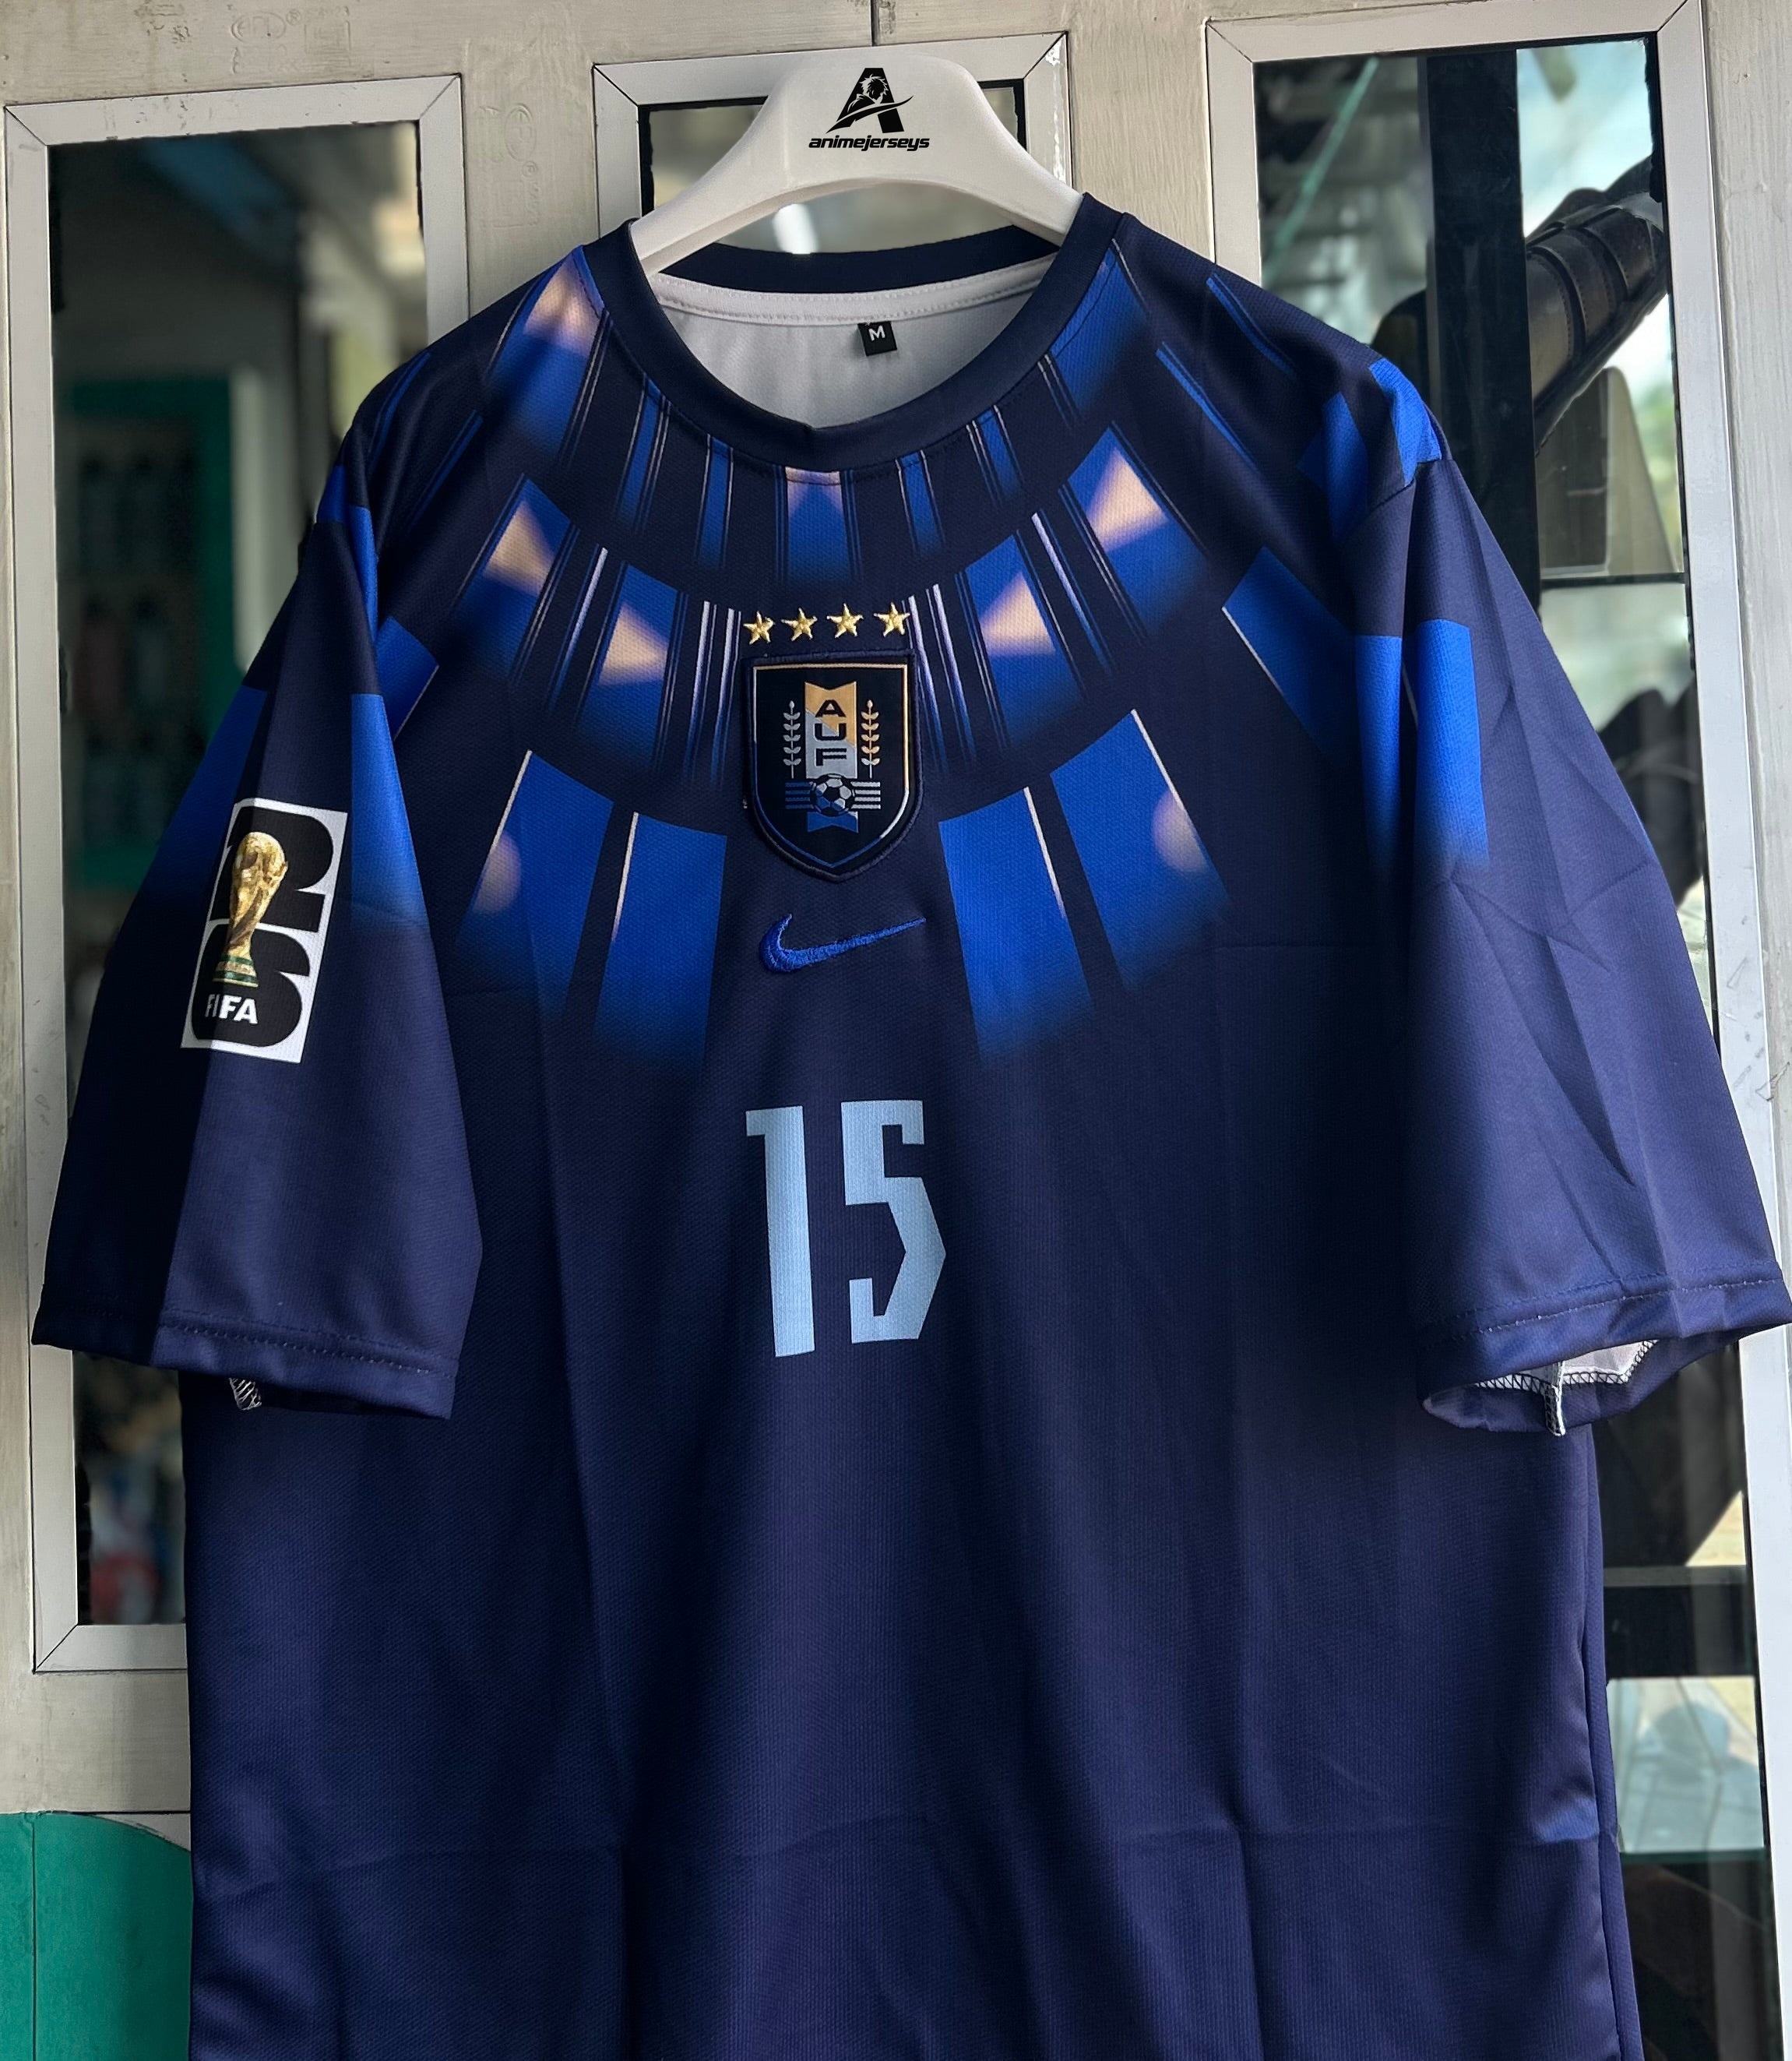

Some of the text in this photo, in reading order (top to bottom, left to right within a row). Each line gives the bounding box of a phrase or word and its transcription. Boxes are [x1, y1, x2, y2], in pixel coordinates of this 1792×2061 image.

[868, 325, 885, 341] M
[815, 699, 847, 766] AUF
[205, 993, 259, 1024] FIFA
[745, 1100, 946, 1358] 15
